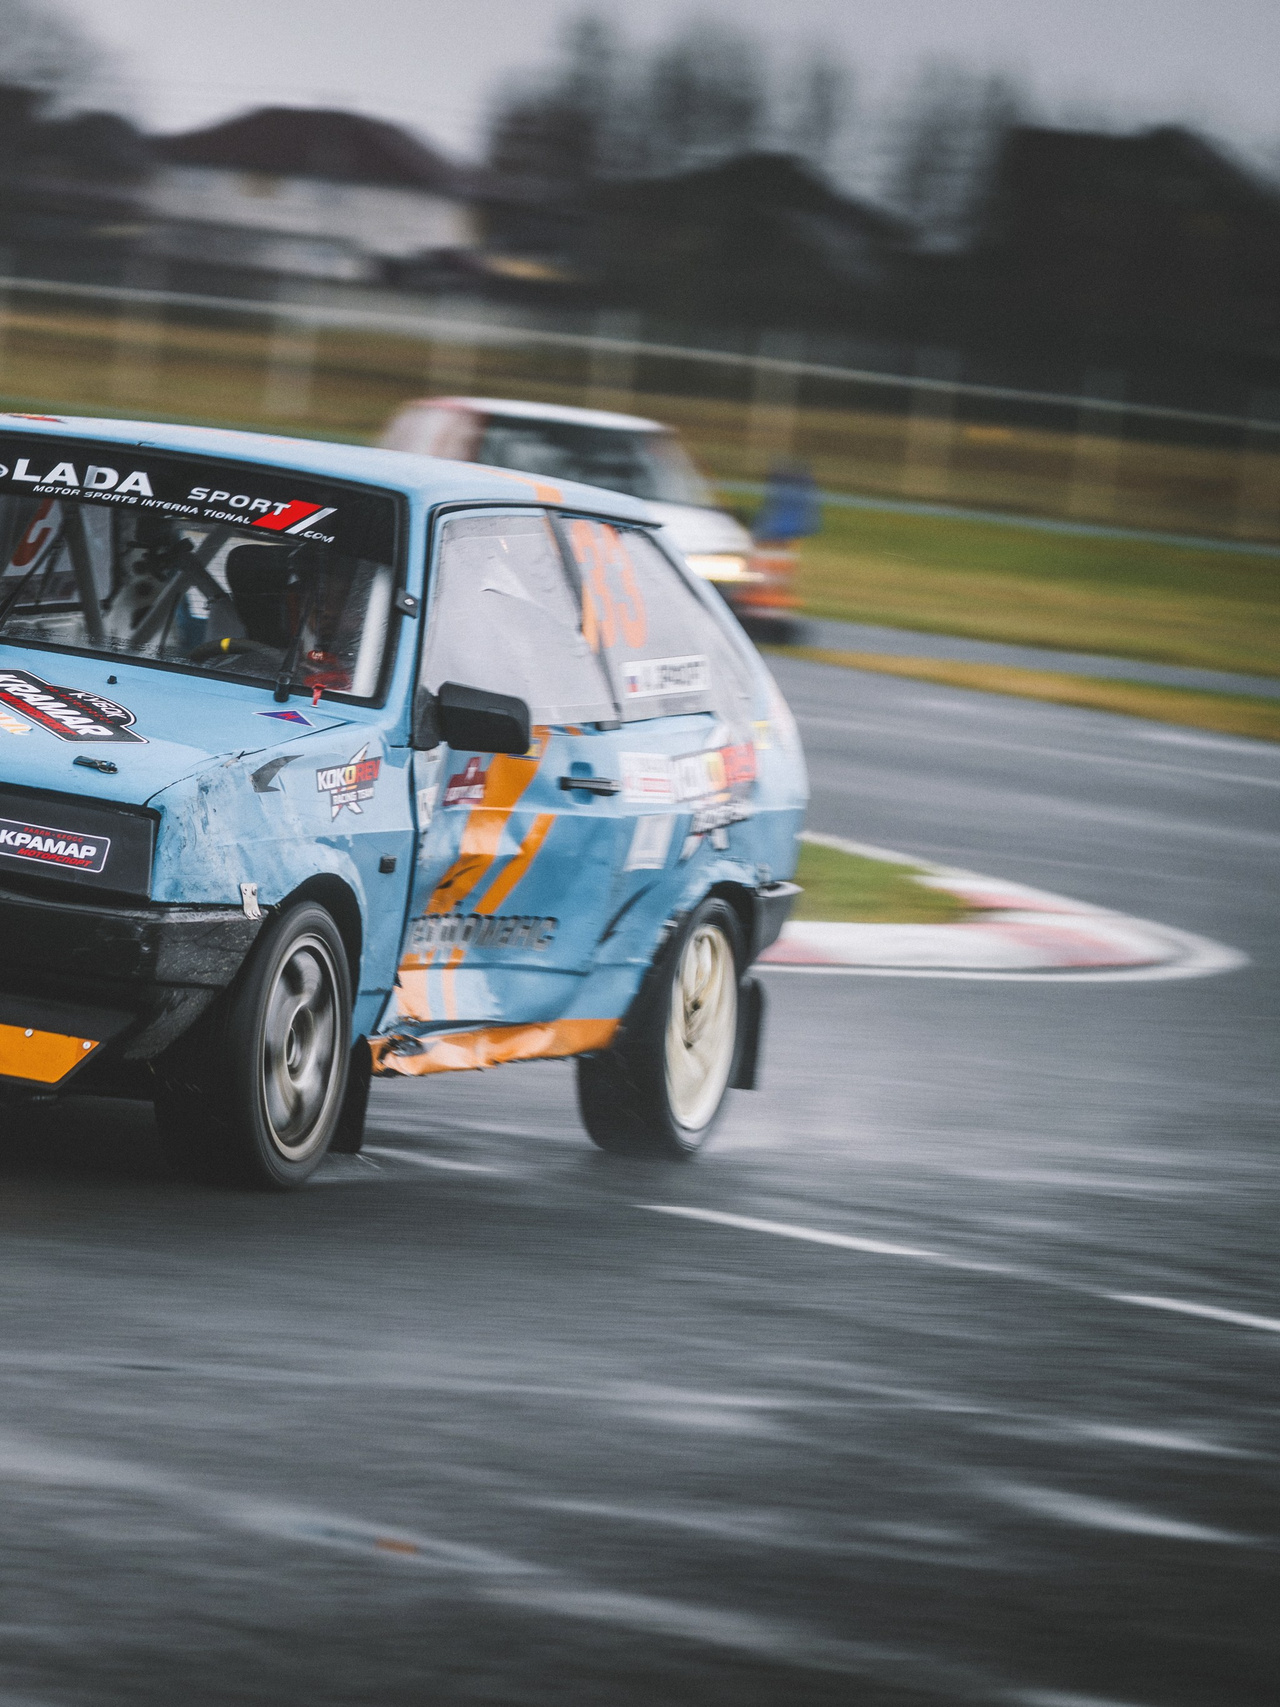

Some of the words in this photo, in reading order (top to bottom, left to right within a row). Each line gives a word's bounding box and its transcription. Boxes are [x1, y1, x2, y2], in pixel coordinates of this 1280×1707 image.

[12, 459, 154, 497] LADA
[33, 485, 81, 496] MOTOR
[83, 490, 138, 504] SPORTS
[187, 487, 292, 516] SPORT
[571, 520, 648, 649] 33
[17, 848, 93, 867] МОТОРСПОРТ
